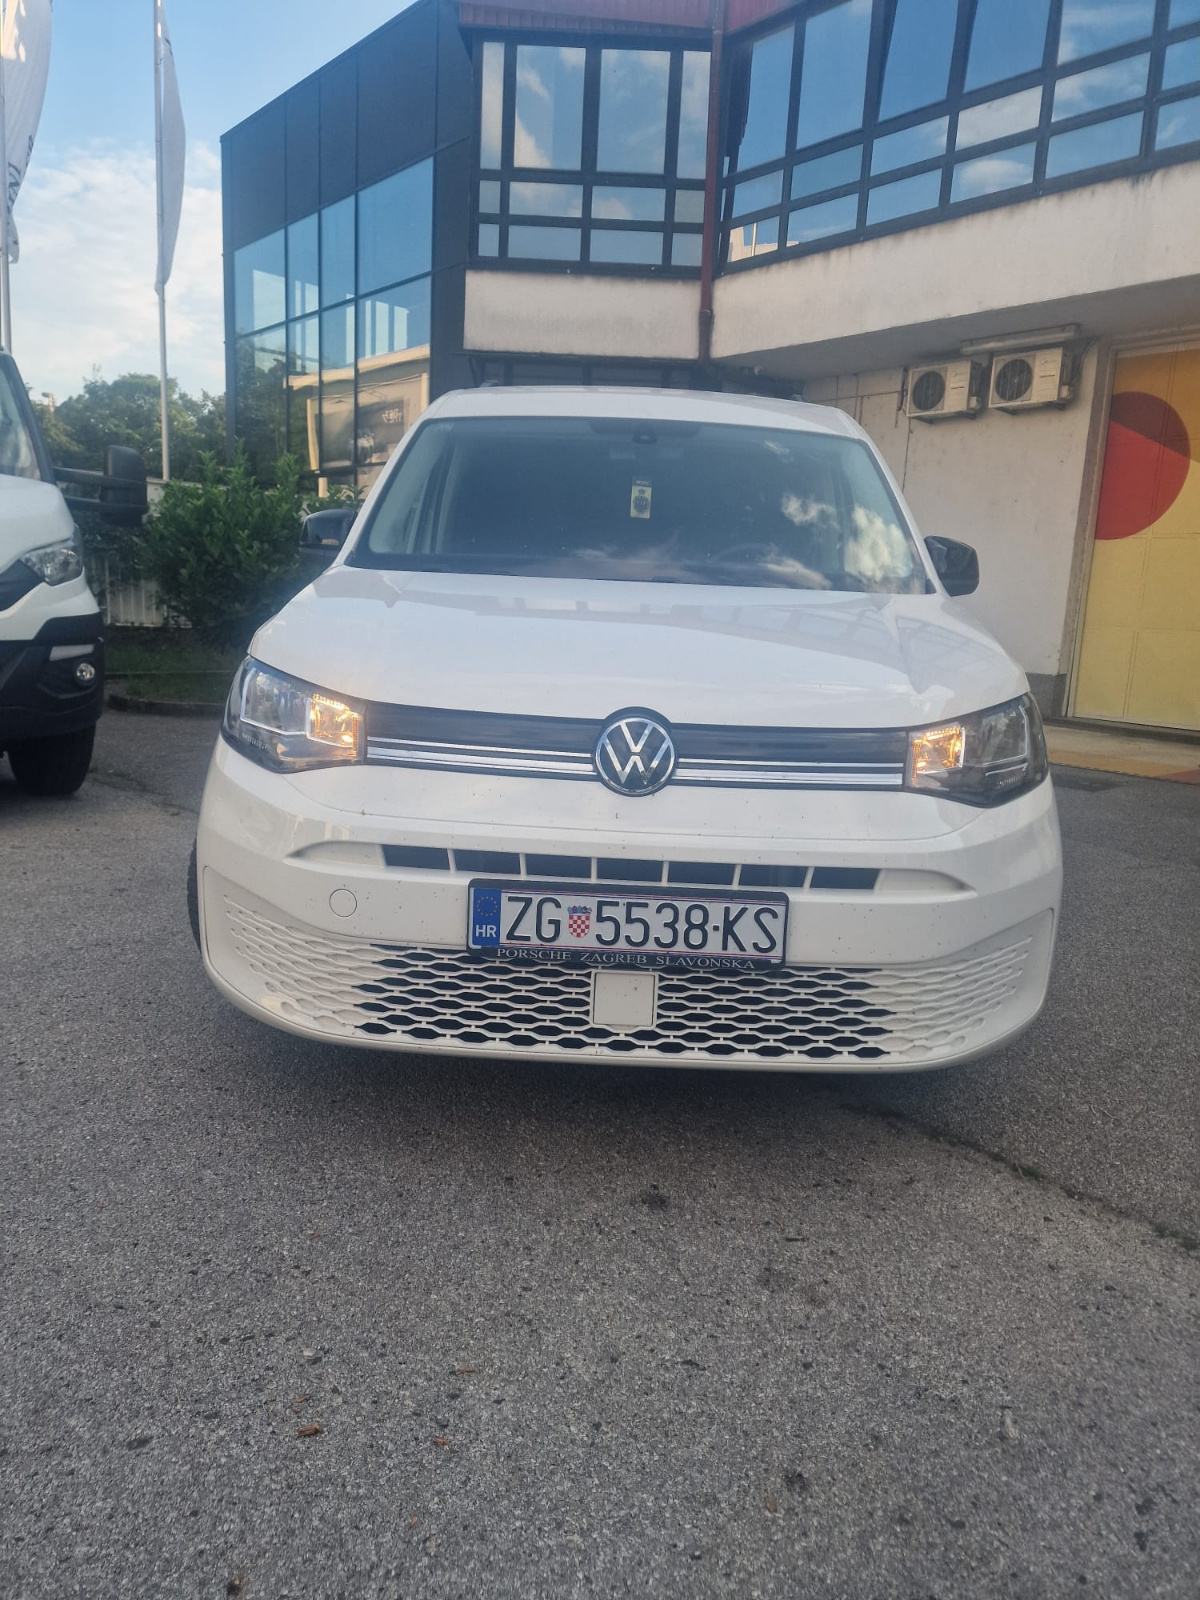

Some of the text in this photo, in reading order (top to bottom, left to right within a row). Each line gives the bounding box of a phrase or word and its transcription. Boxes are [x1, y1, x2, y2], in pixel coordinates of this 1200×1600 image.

[475, 924, 497, 937] HR
[506, 896, 562, 943] ZG
[497, 947, 755, 969] PORSCHE ZAGREB SLAVONSKA
